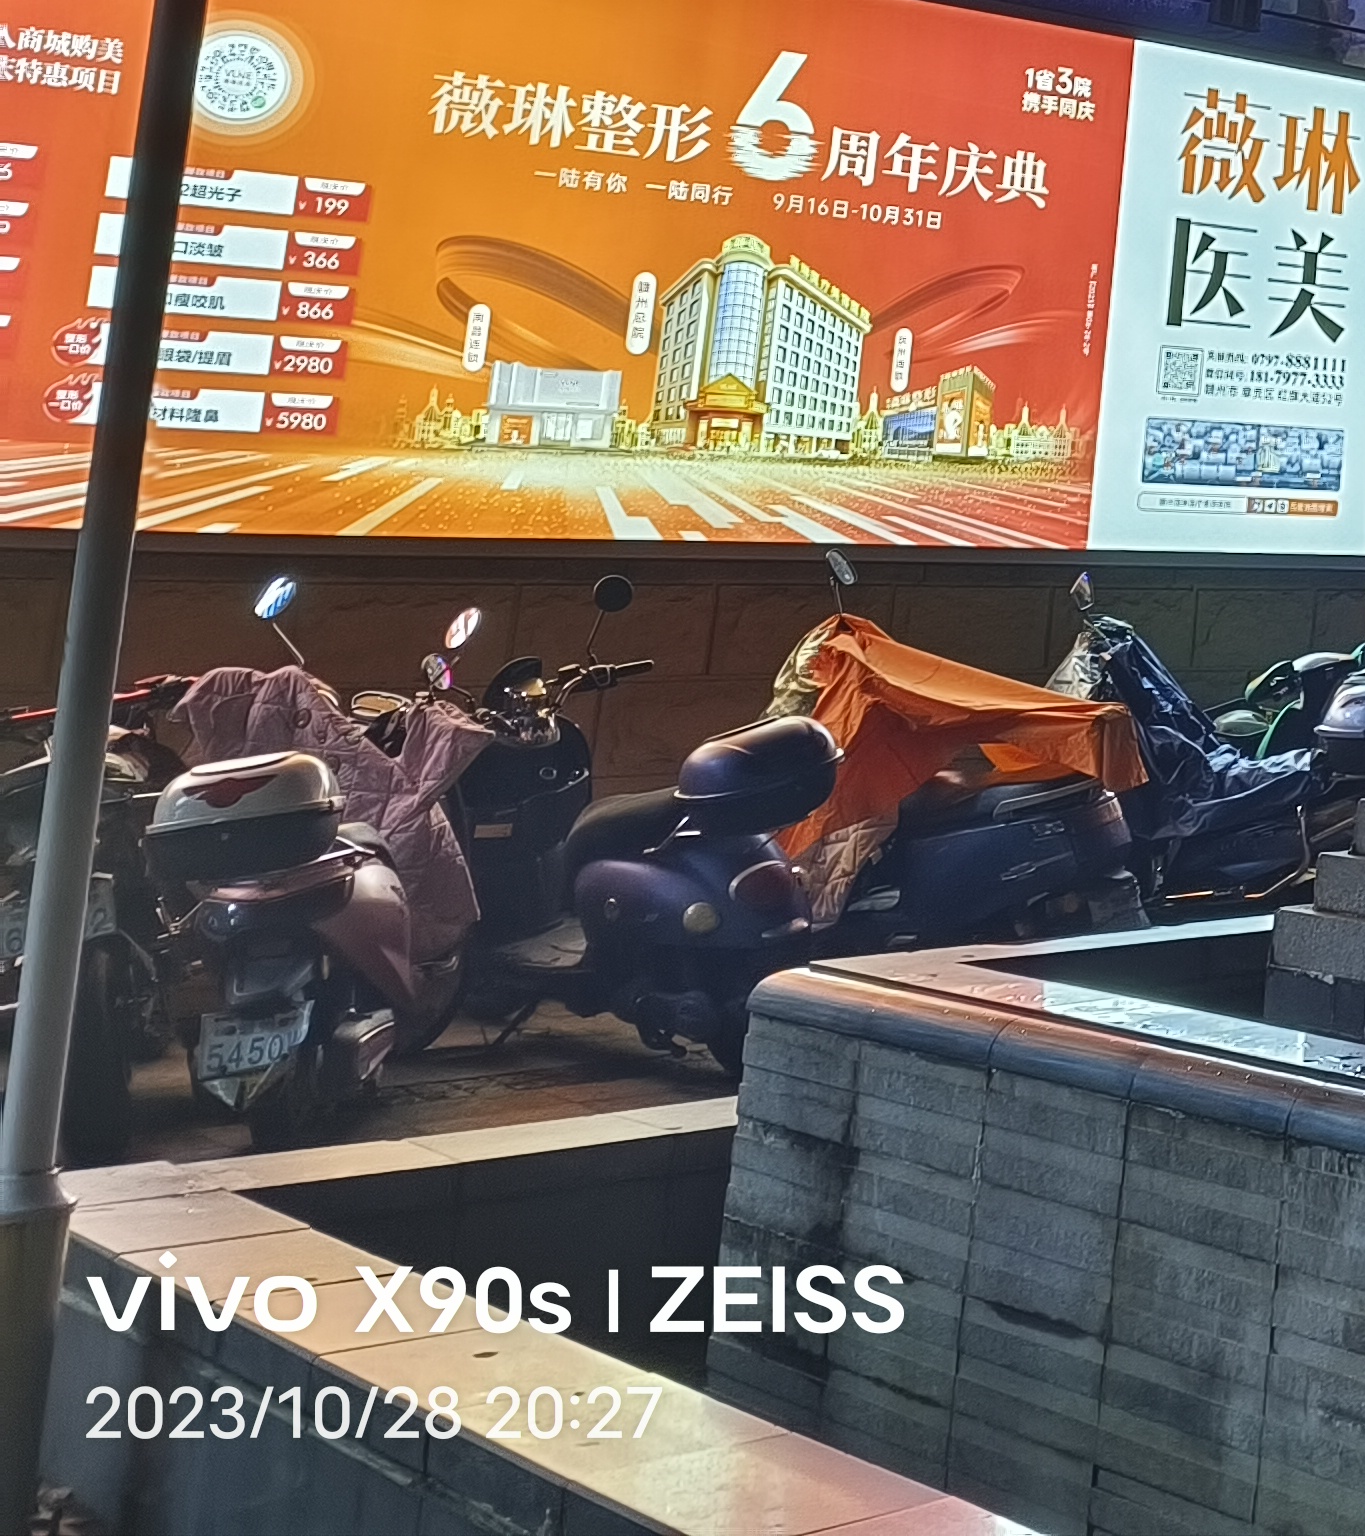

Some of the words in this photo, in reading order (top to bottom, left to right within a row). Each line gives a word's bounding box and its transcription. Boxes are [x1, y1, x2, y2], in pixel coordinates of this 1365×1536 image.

[1024, 66, 1093, 99] 1省3院
[1021, 91, 1097, 122] 携手同庆
[1179, 87, 1361, 215] 薇琳
[534, 167, 628, 194] 一陆有你
[645, 179, 735, 207] 一陆同行
[315, 196, 349, 216] 199
[773, 192, 943, 231] 9月16日-10月31日
[302, 251, 340, 270] 366
[1166, 217, 1349, 344] 医美
[296, 301, 334, 321] 866
